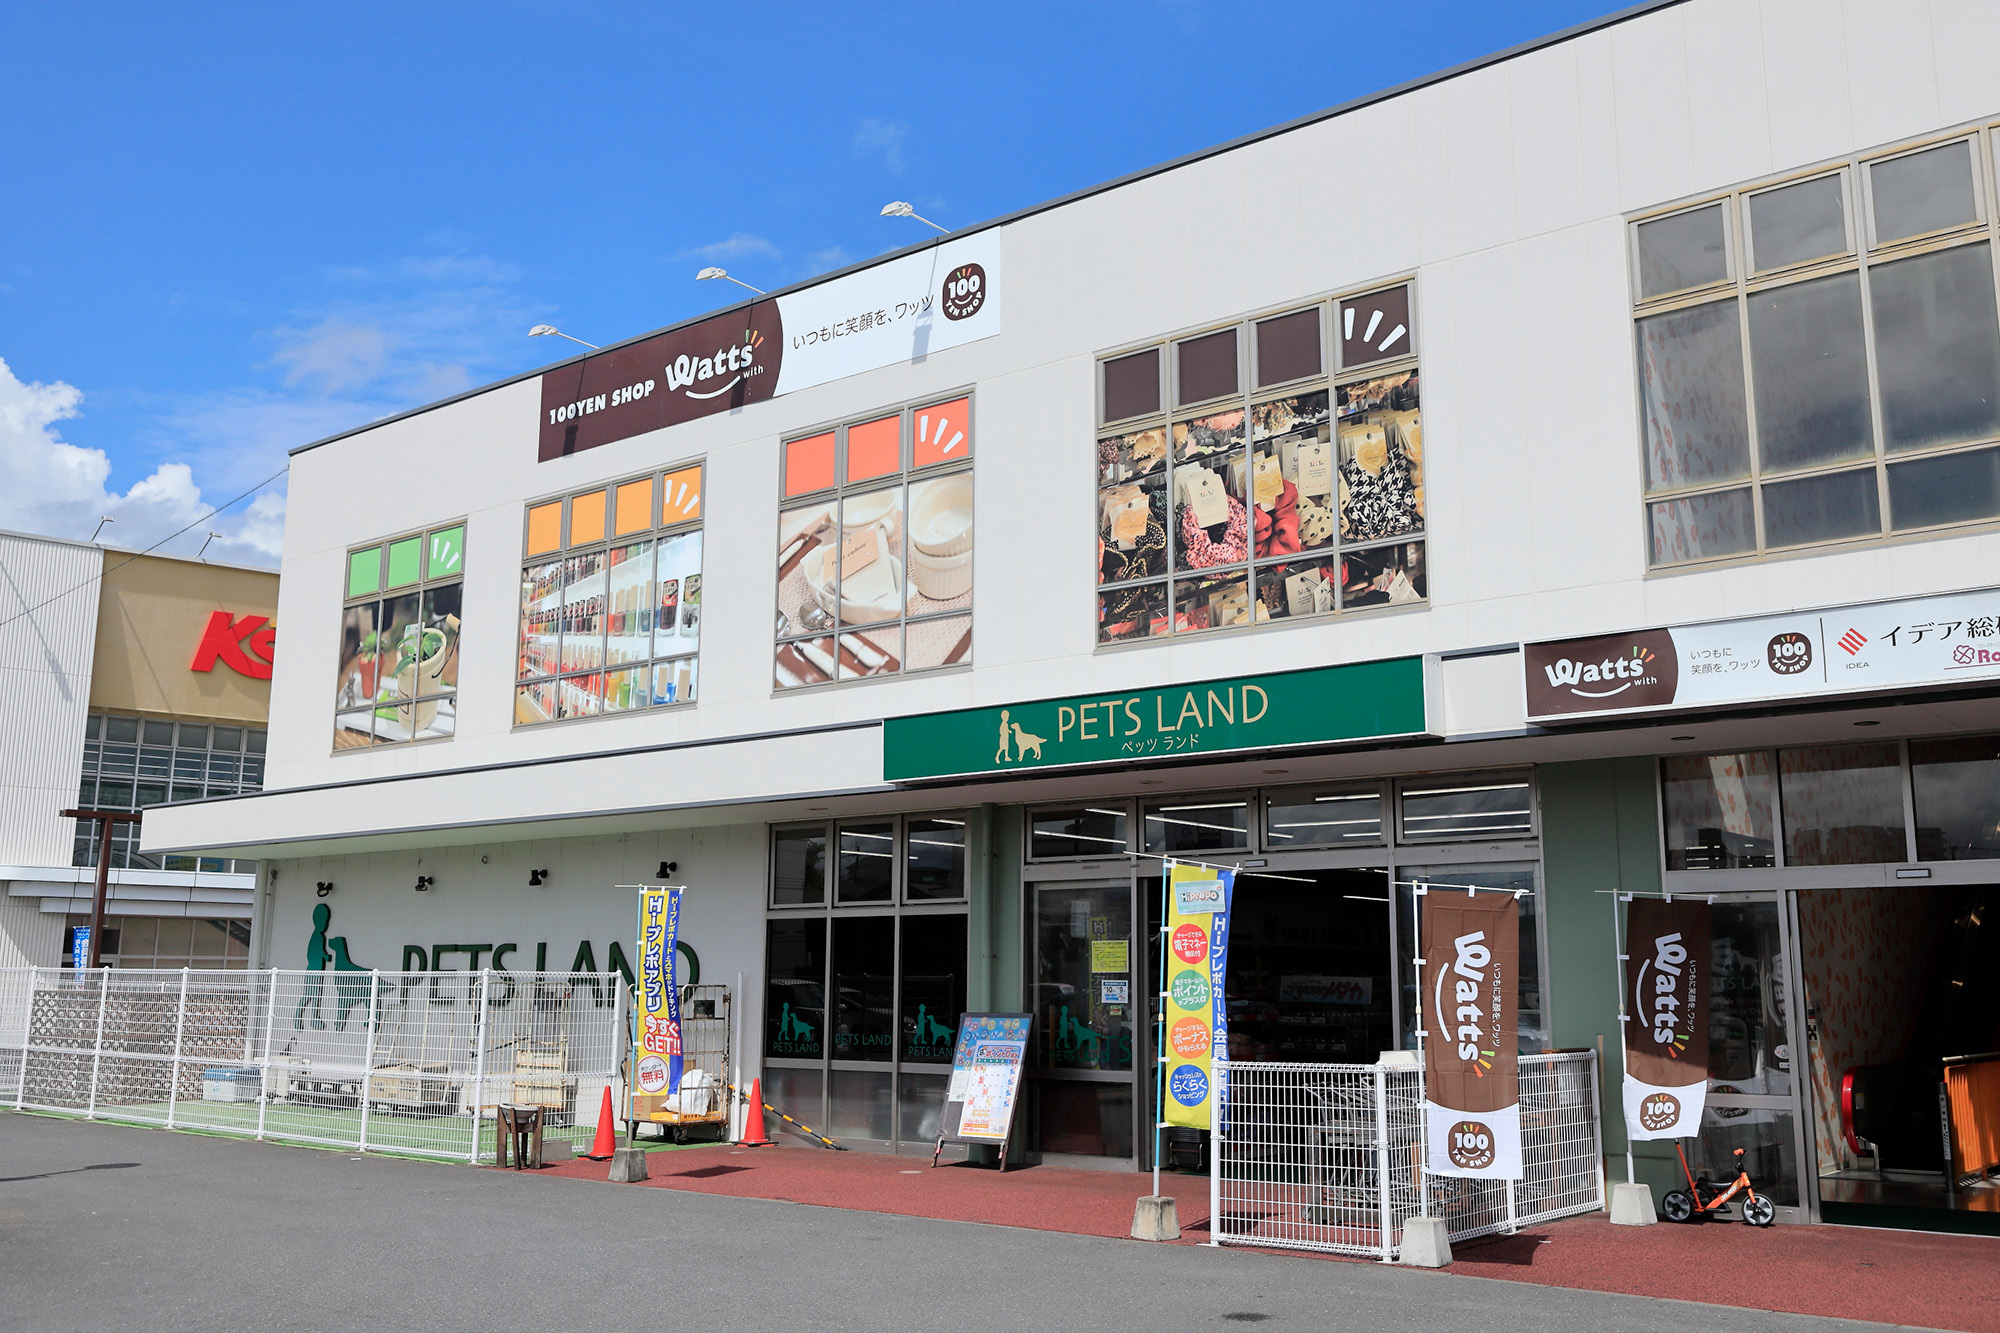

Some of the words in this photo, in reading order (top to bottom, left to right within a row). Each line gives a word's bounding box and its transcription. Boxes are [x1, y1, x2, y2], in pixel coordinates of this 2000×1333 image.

[948, 274, 981, 299] 100
[945, 299, 961, 317] YEN
[961, 291, 983, 316] SHOP
[793, 294, 934, 350] いつもに笑顔を、ワッツ
[665, 342, 754, 393] Watts
[742, 364, 764, 380] with
[550, 395, 606, 425] 100YEN
[611, 379, 656, 407] SHOP
[1690, 646, 1733, 660] いつもに
[1773, 641, 1807, 658] 100
[1544, 655, 1645, 688] Watts
[1634, 675, 1658, 687] with
[1690, 658, 1761, 676] 笑顔を、ワッツ
[1771, 657, 1788, 673] YEN
[1788, 654, 1809, 673] SHOP
[1845, 661, 1870, 670] IDEA
[1058, 695, 1142, 743] PETS
[1155, 684, 1269, 732] LAND
[1120, 735, 1158, 753] ペッツ
[1162, 732, 1200, 751] ランド
[1174, 938, 1207, 951] 電子マネー
[644, 896, 664, 1012] Hiプレポアプリ
[401, 943, 518, 1007] PETS
[1173, 983, 1209, 998] ポイント
[1454, 931, 1492, 1061] Watts
[1654, 932, 1687, 1044] Watts
[645, 1014, 681, 1038] 今すぐ
[644, 1032, 681, 1055] GET!!
[835, 1033, 860, 1045] PETS
[861, 1034, 892, 1047] LAND
[1173, 1030, 1209, 1045] ボーナス
[773, 1041, 793, 1052] PETS
[794, 1042, 820, 1053] LAND
[908, 1046, 931, 1057] PETS
[933, 1047, 954, 1058] LAN
[1177, 1042, 1207, 1053] がもらえる
[641, 1069, 664, 1085] 無料
[1172, 1077, 1208, 1093] らくらく
[1177, 1090, 1205, 1100] ショッピング
[1646, 1101, 1676, 1116] 100
[1454, 1132, 1489, 1150] 100
[1469, 1150, 1492, 1168] SHOP
